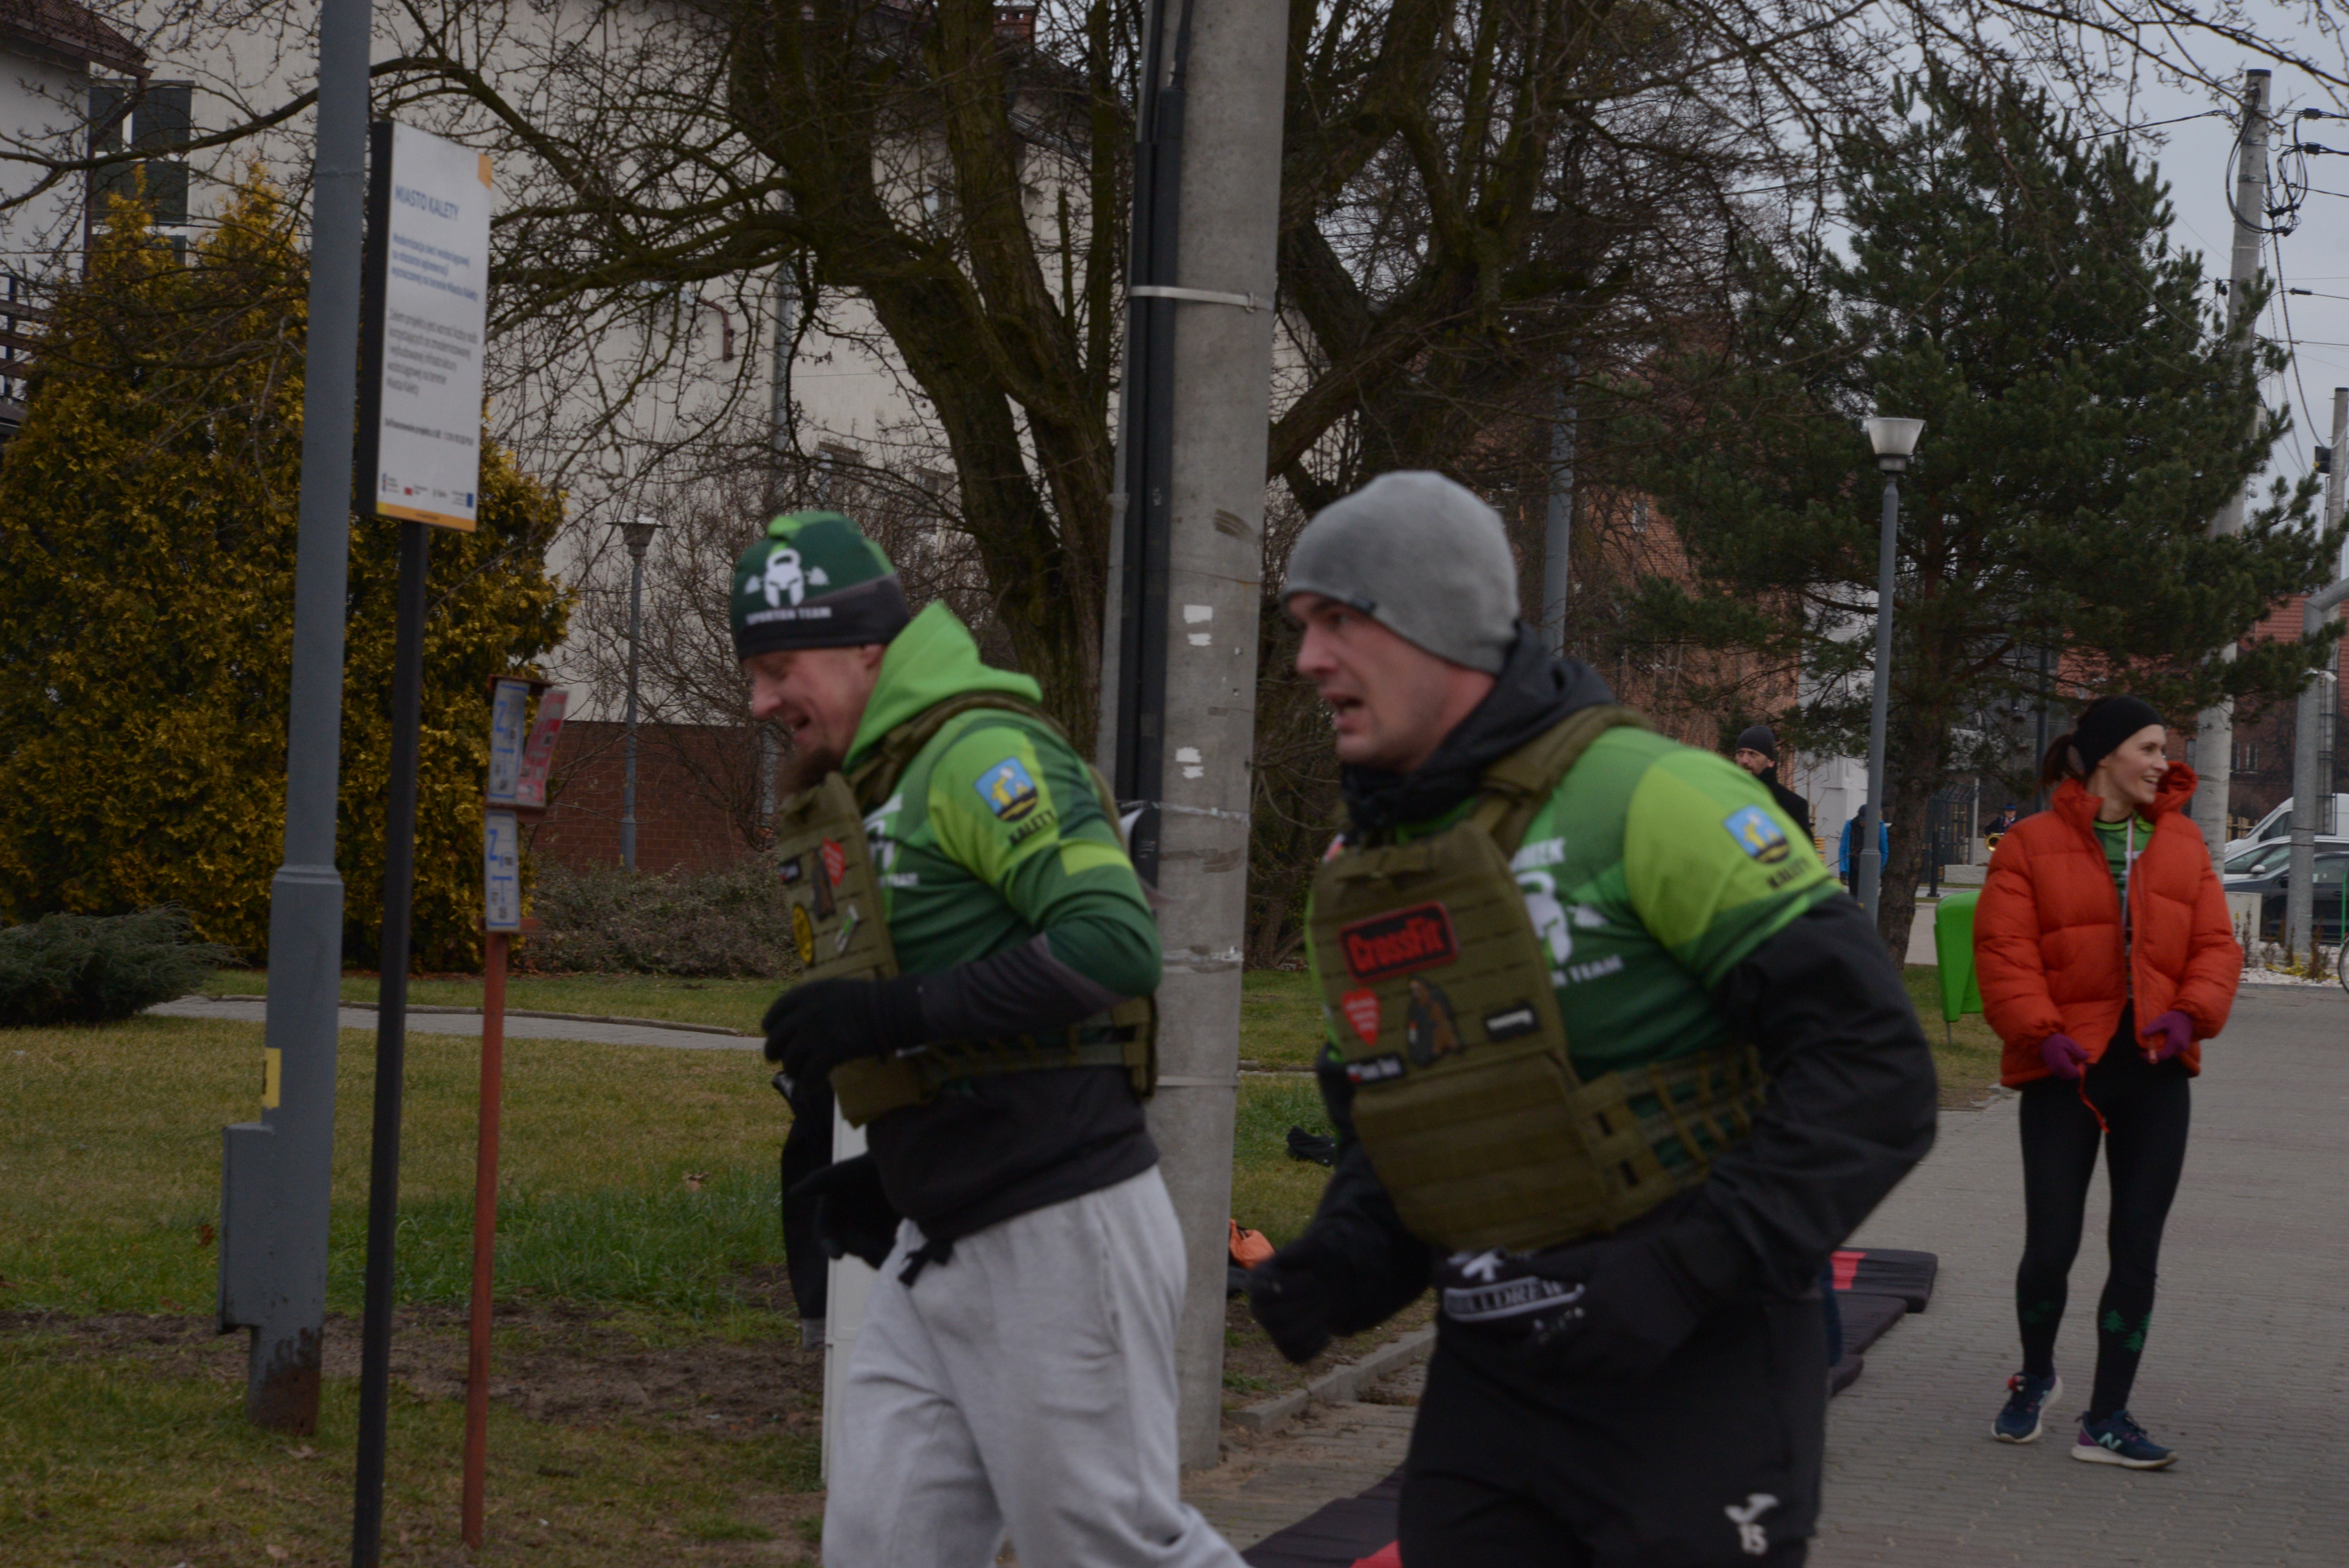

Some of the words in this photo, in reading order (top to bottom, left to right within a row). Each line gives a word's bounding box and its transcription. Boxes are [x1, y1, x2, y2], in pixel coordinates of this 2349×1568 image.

[395, 185, 426, 210] MIASTO
[429, 198, 459, 221] KALETY
[798, 606, 832, 620] TEAM
[1568, 953, 1625, 984] TEAM
